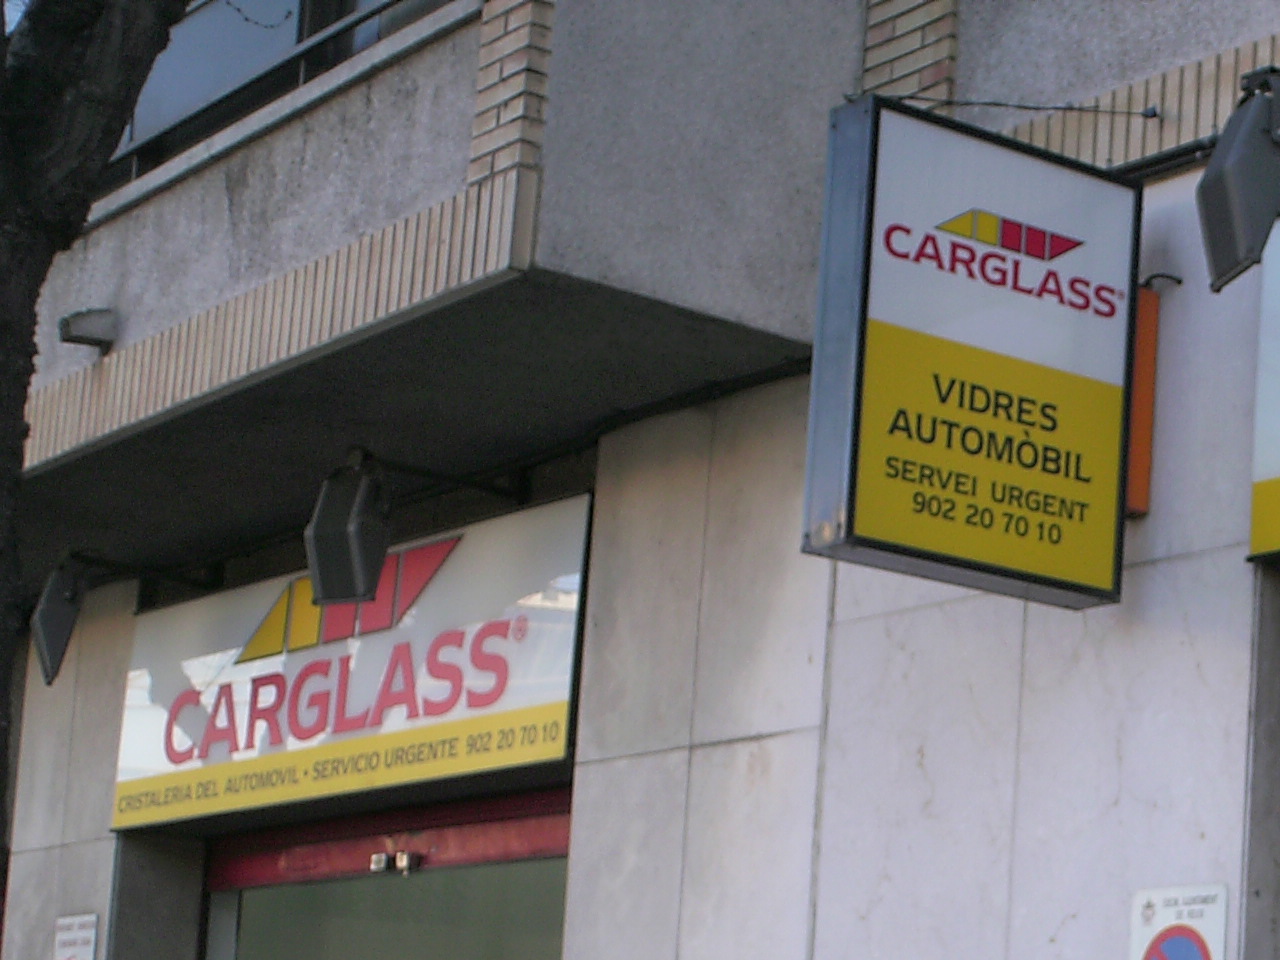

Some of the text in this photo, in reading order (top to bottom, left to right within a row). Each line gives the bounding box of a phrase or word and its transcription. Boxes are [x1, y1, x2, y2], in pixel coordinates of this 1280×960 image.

[883, 223, 1116, 319] CARGLASS
[933, 373, 1058, 432] VIDRES
[888, 408, 1092, 483] AUTOMÒBIL
[885, 455, 1090, 522] SERVEI URGENT
[912, 491, 1062, 545] 902 20 70 10
[194, 780, 218, 799] DEL
[312, 751, 379, 780] SERVICIO
[384, 737, 459, 768] URGENTE
[466, 730, 493, 754] 902
[496, 727, 515, 750] 20
[520, 724, 538, 746] 70
[542, 720, 560, 744] 10
